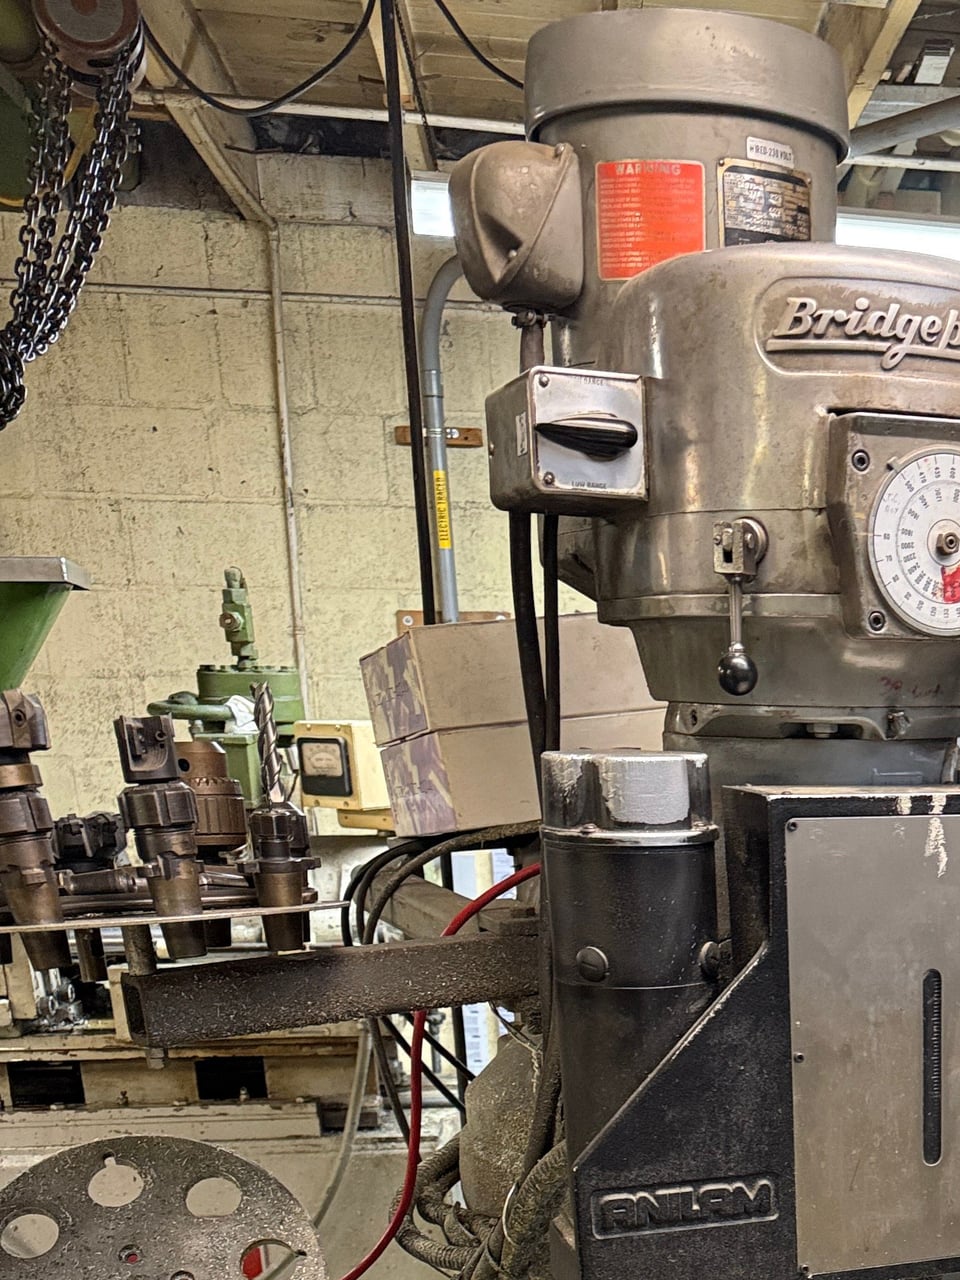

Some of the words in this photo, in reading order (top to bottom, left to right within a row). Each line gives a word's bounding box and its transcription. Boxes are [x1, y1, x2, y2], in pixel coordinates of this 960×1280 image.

[615, 163, 681, 175] WARNING
[437, 507, 449, 541] ELECTRIC
[885, 554, 893, 562] 70
[600, 1179, 774, 1229] ANILAM
